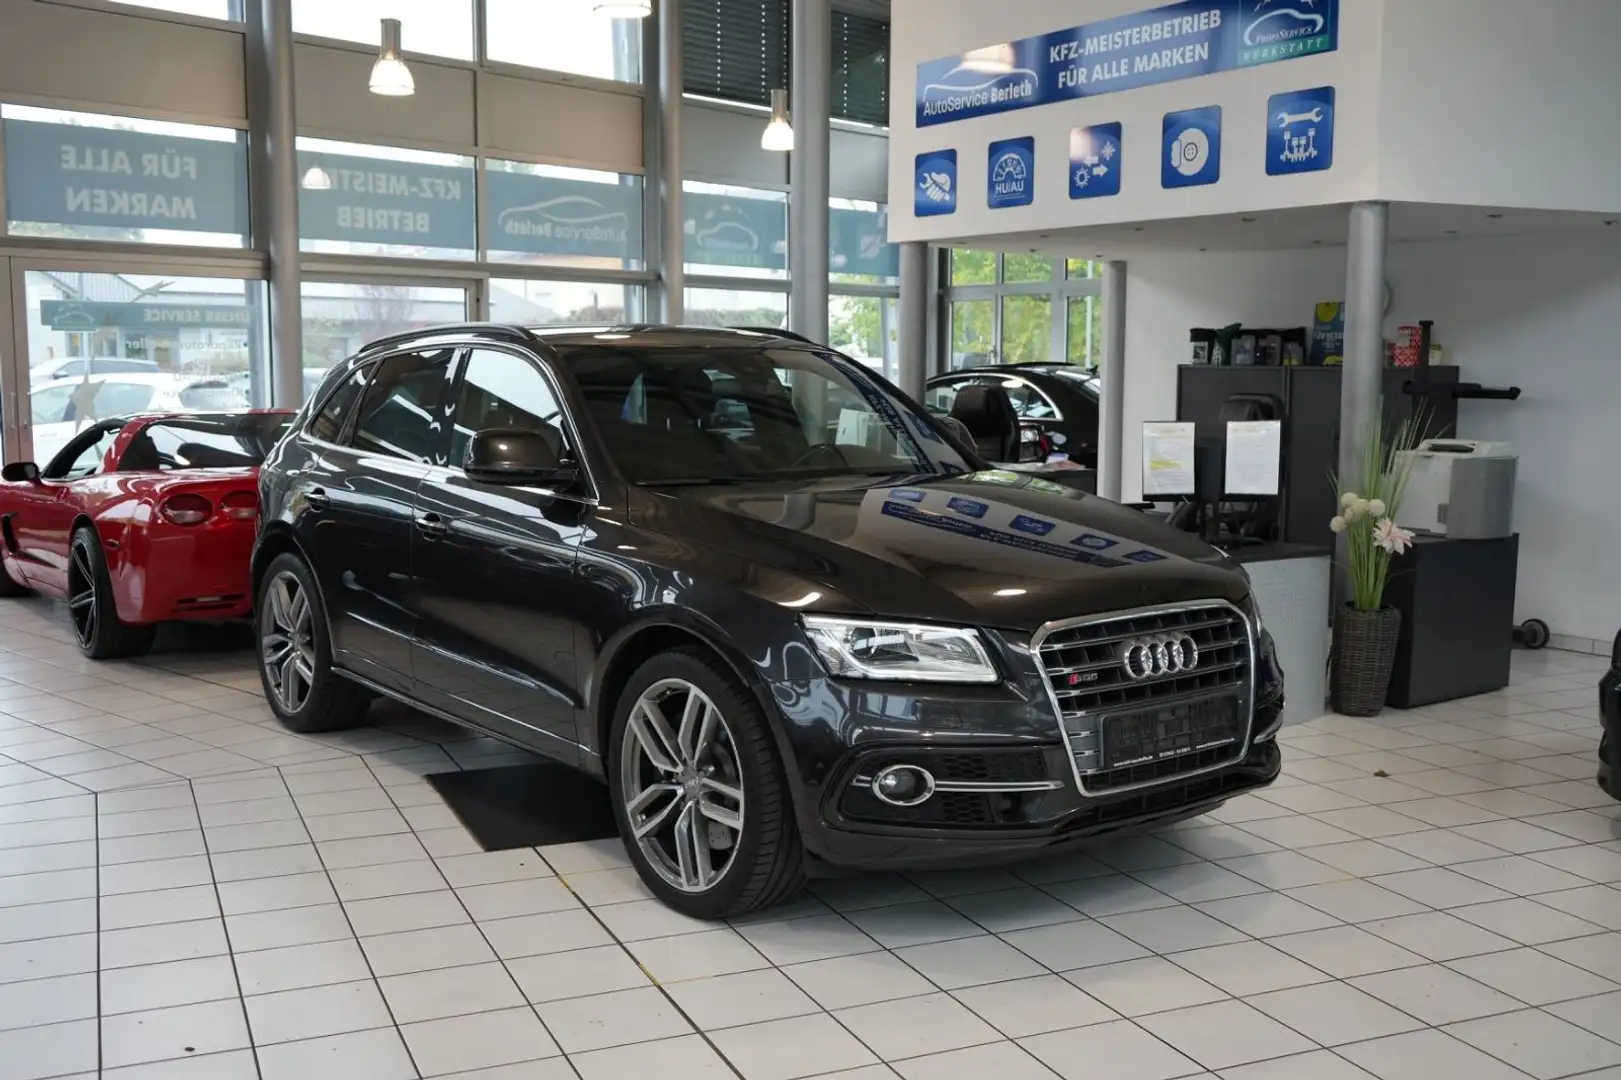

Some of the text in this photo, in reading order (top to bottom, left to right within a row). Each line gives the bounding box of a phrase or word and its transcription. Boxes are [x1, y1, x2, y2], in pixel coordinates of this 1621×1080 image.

[1049, 9, 1221, 63] KFZ-MEISTERBETRIEB
[1243, 38, 1324, 60] WERKSTATT
[1058, 42, 1209, 89] FÜR ALLE MARKEN
[923, 79, 1032, 116] AutoService Berleth
